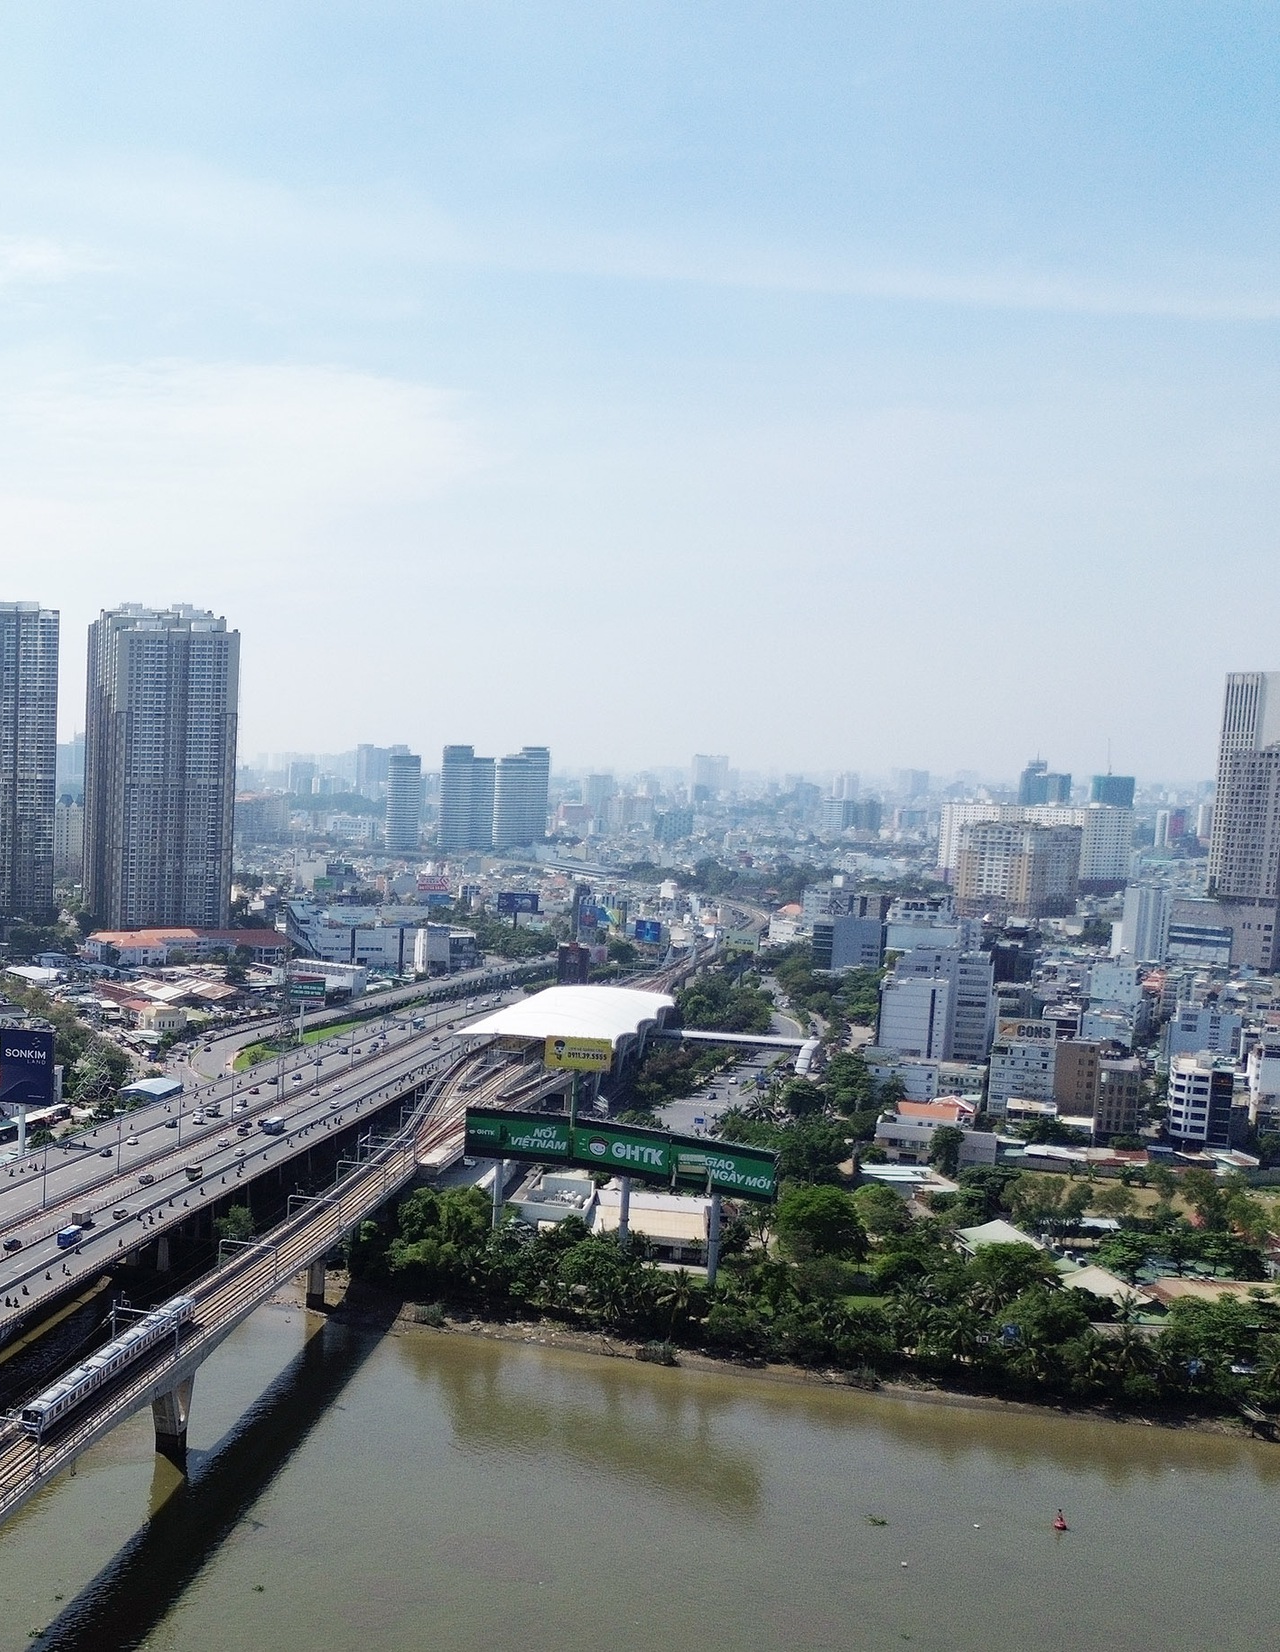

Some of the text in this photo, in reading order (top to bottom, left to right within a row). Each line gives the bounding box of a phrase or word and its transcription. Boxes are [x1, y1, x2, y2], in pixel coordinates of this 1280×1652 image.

[1017, 1025, 1051, 1039] CONS
[5, 1048, 46, 1059] SONKIM
[611, 1142, 663, 1166] GHTK
[705, 1157, 735, 1171] GIAO
[711, 1169, 745, 1184] NGÀY
